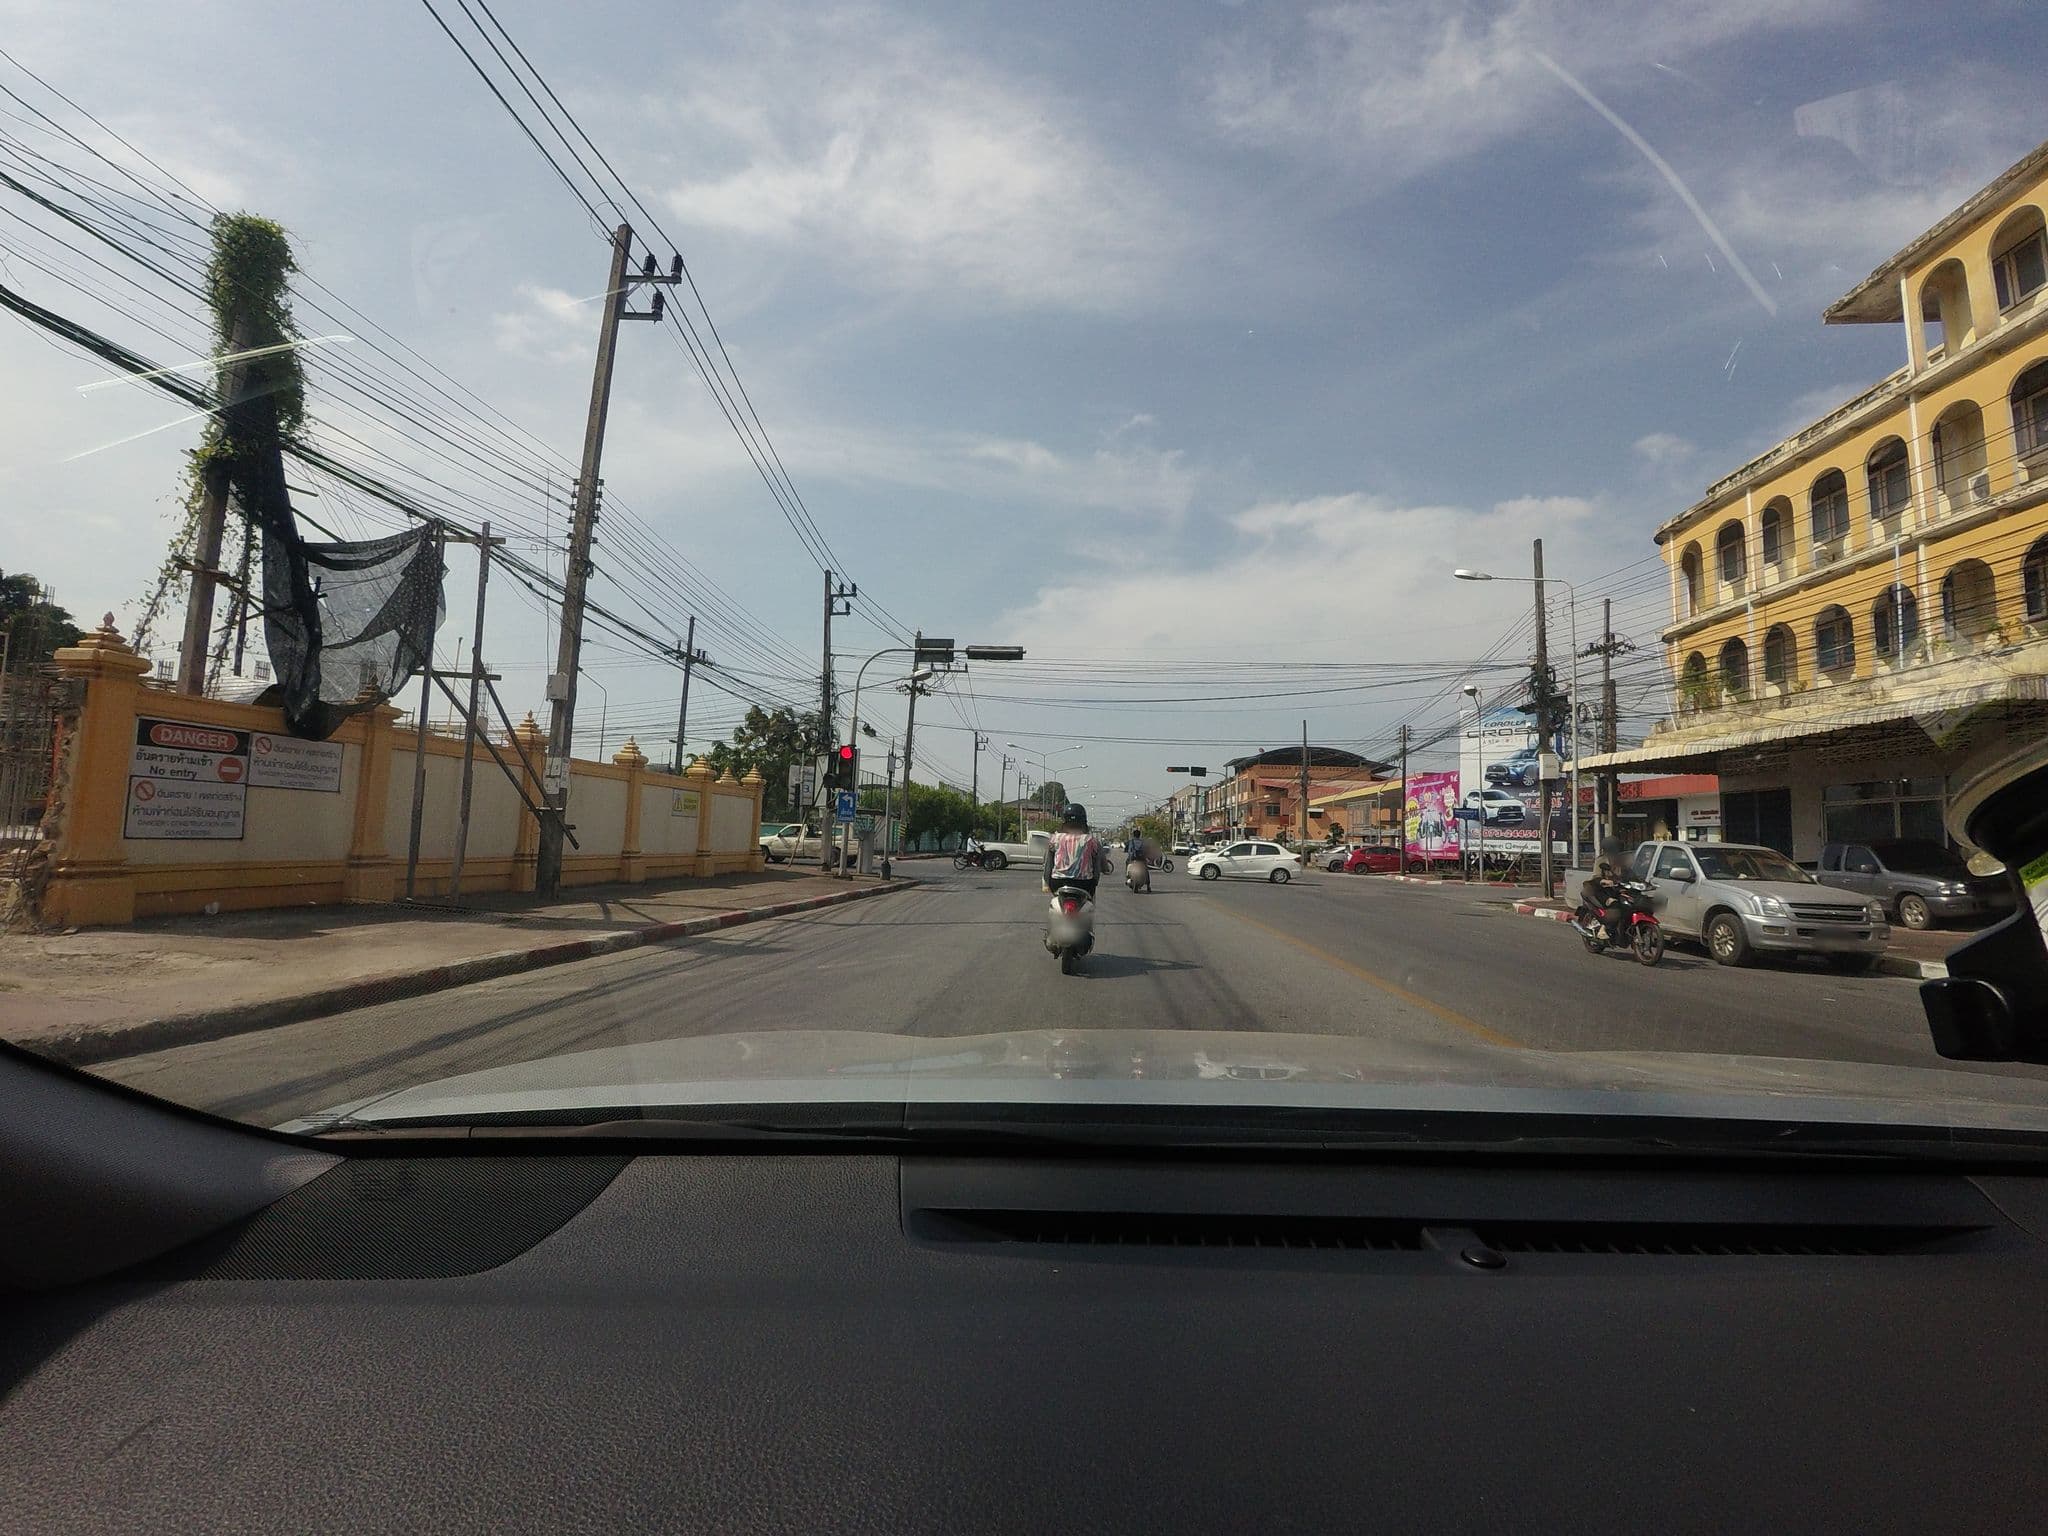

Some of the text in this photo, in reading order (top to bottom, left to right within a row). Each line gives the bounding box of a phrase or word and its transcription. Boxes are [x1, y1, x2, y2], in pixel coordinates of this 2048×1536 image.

[1484, 719, 1527, 728] COROLLA
[160, 728, 229, 748] DANGER
[149, 765, 198, 780] No entry
